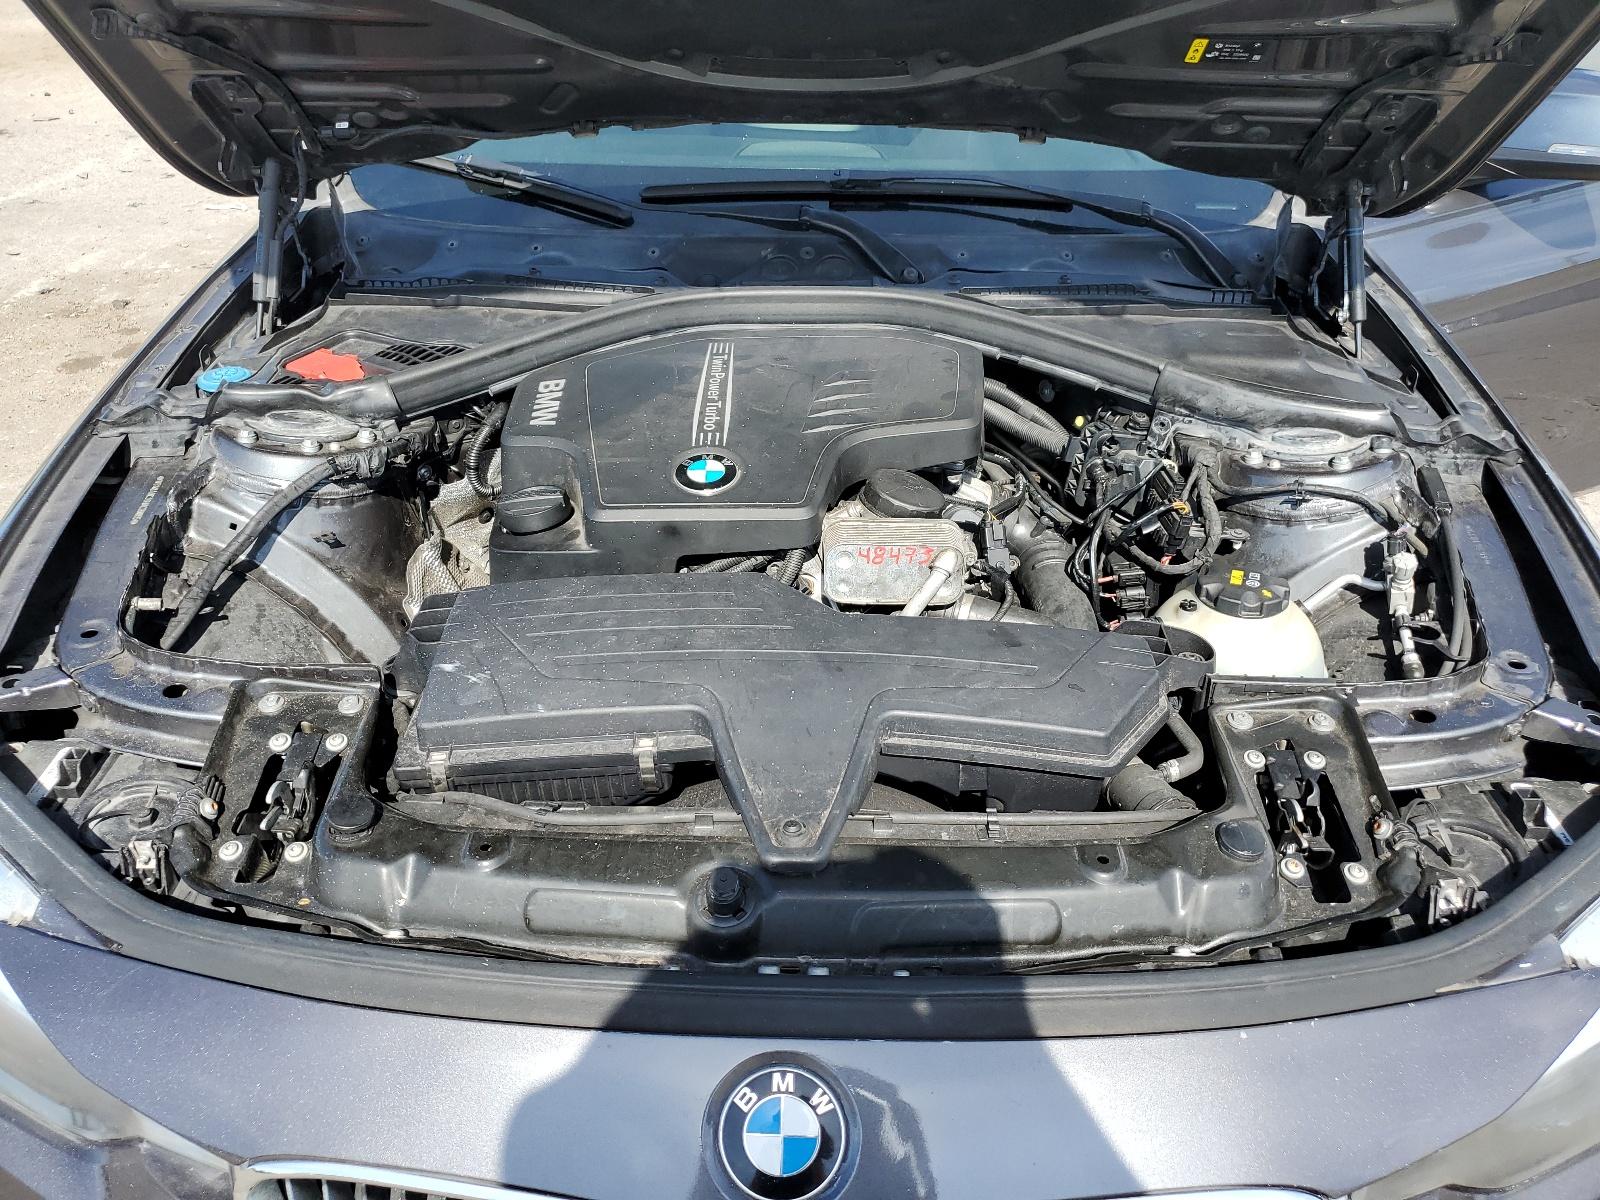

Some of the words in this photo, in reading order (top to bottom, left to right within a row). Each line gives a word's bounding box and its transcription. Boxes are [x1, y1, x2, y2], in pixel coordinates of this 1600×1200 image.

[529, 378, 567, 426] BMW
[681, 454, 734, 467] BMW
[857, 545, 936, 567] 48473
[733, 1072, 835, 1116] BMW
